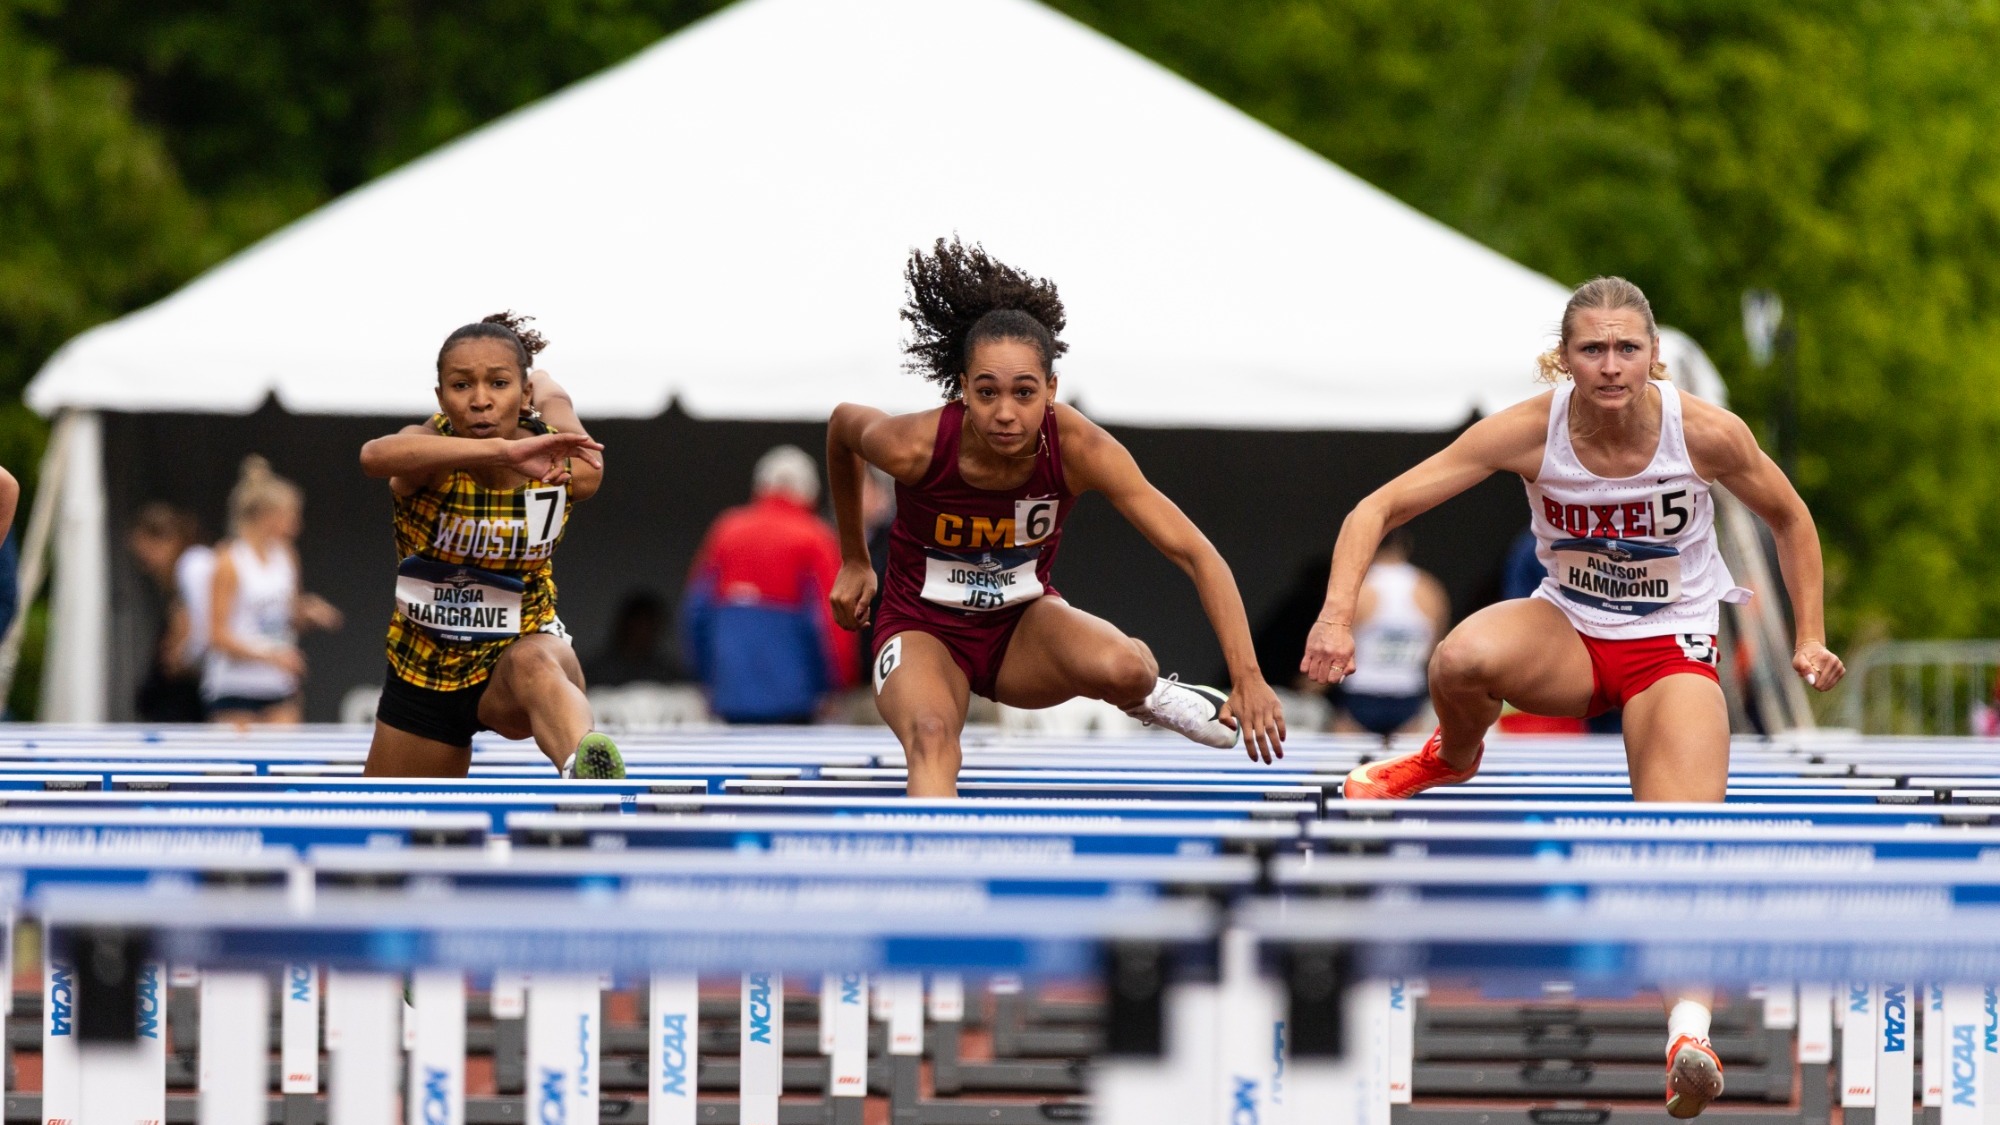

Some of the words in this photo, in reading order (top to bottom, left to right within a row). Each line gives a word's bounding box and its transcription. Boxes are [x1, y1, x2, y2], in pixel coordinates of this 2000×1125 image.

[534, 491, 559, 542] 7
[934, 513, 1043, 549] CM
[1026, 503, 1051, 540] 6
[1662, 489, 1689, 536] 5
[1569, 566, 1669, 598] HAMMOND
[1587, 556, 1648, 580] ALLYSON
[433, 587, 484, 604] DAYSIA
[408, 603, 508, 628] HARGRAVE
[879, 643, 896, 681] 6
[50, 963, 72, 1036] NCAA
[1884, 980, 1906, 1053] NCAA
[663, 1013, 687, 1098] NCAA
[1953, 1024, 1976, 1107] NCAA
